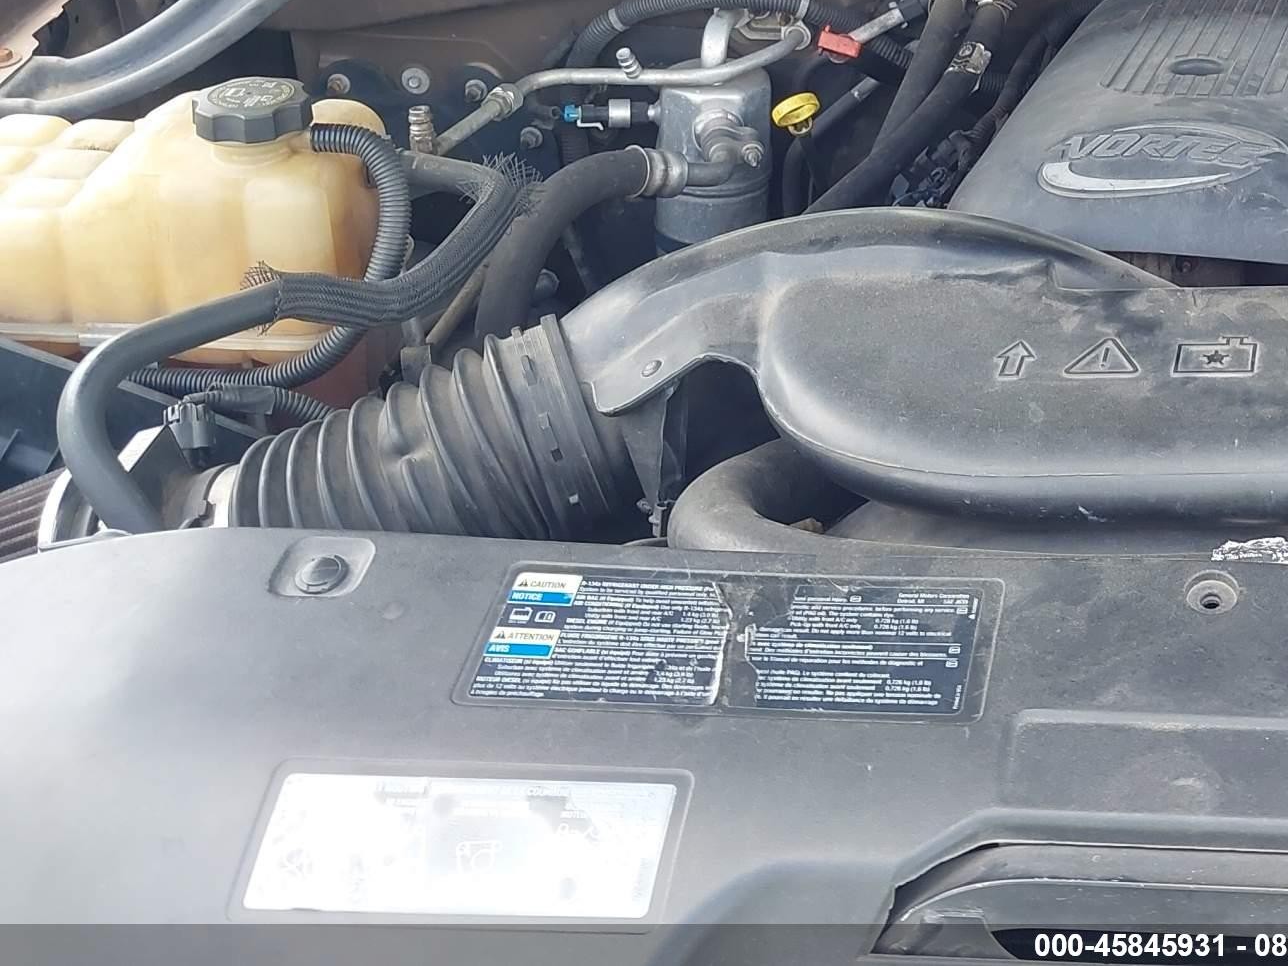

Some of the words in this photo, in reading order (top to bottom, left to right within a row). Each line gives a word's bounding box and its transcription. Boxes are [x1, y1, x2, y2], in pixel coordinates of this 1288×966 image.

[511, 592, 543, 601] NOTICE
[508, 633, 555, 641] ATTENTION
[487, 645, 511, 653] AVIS
